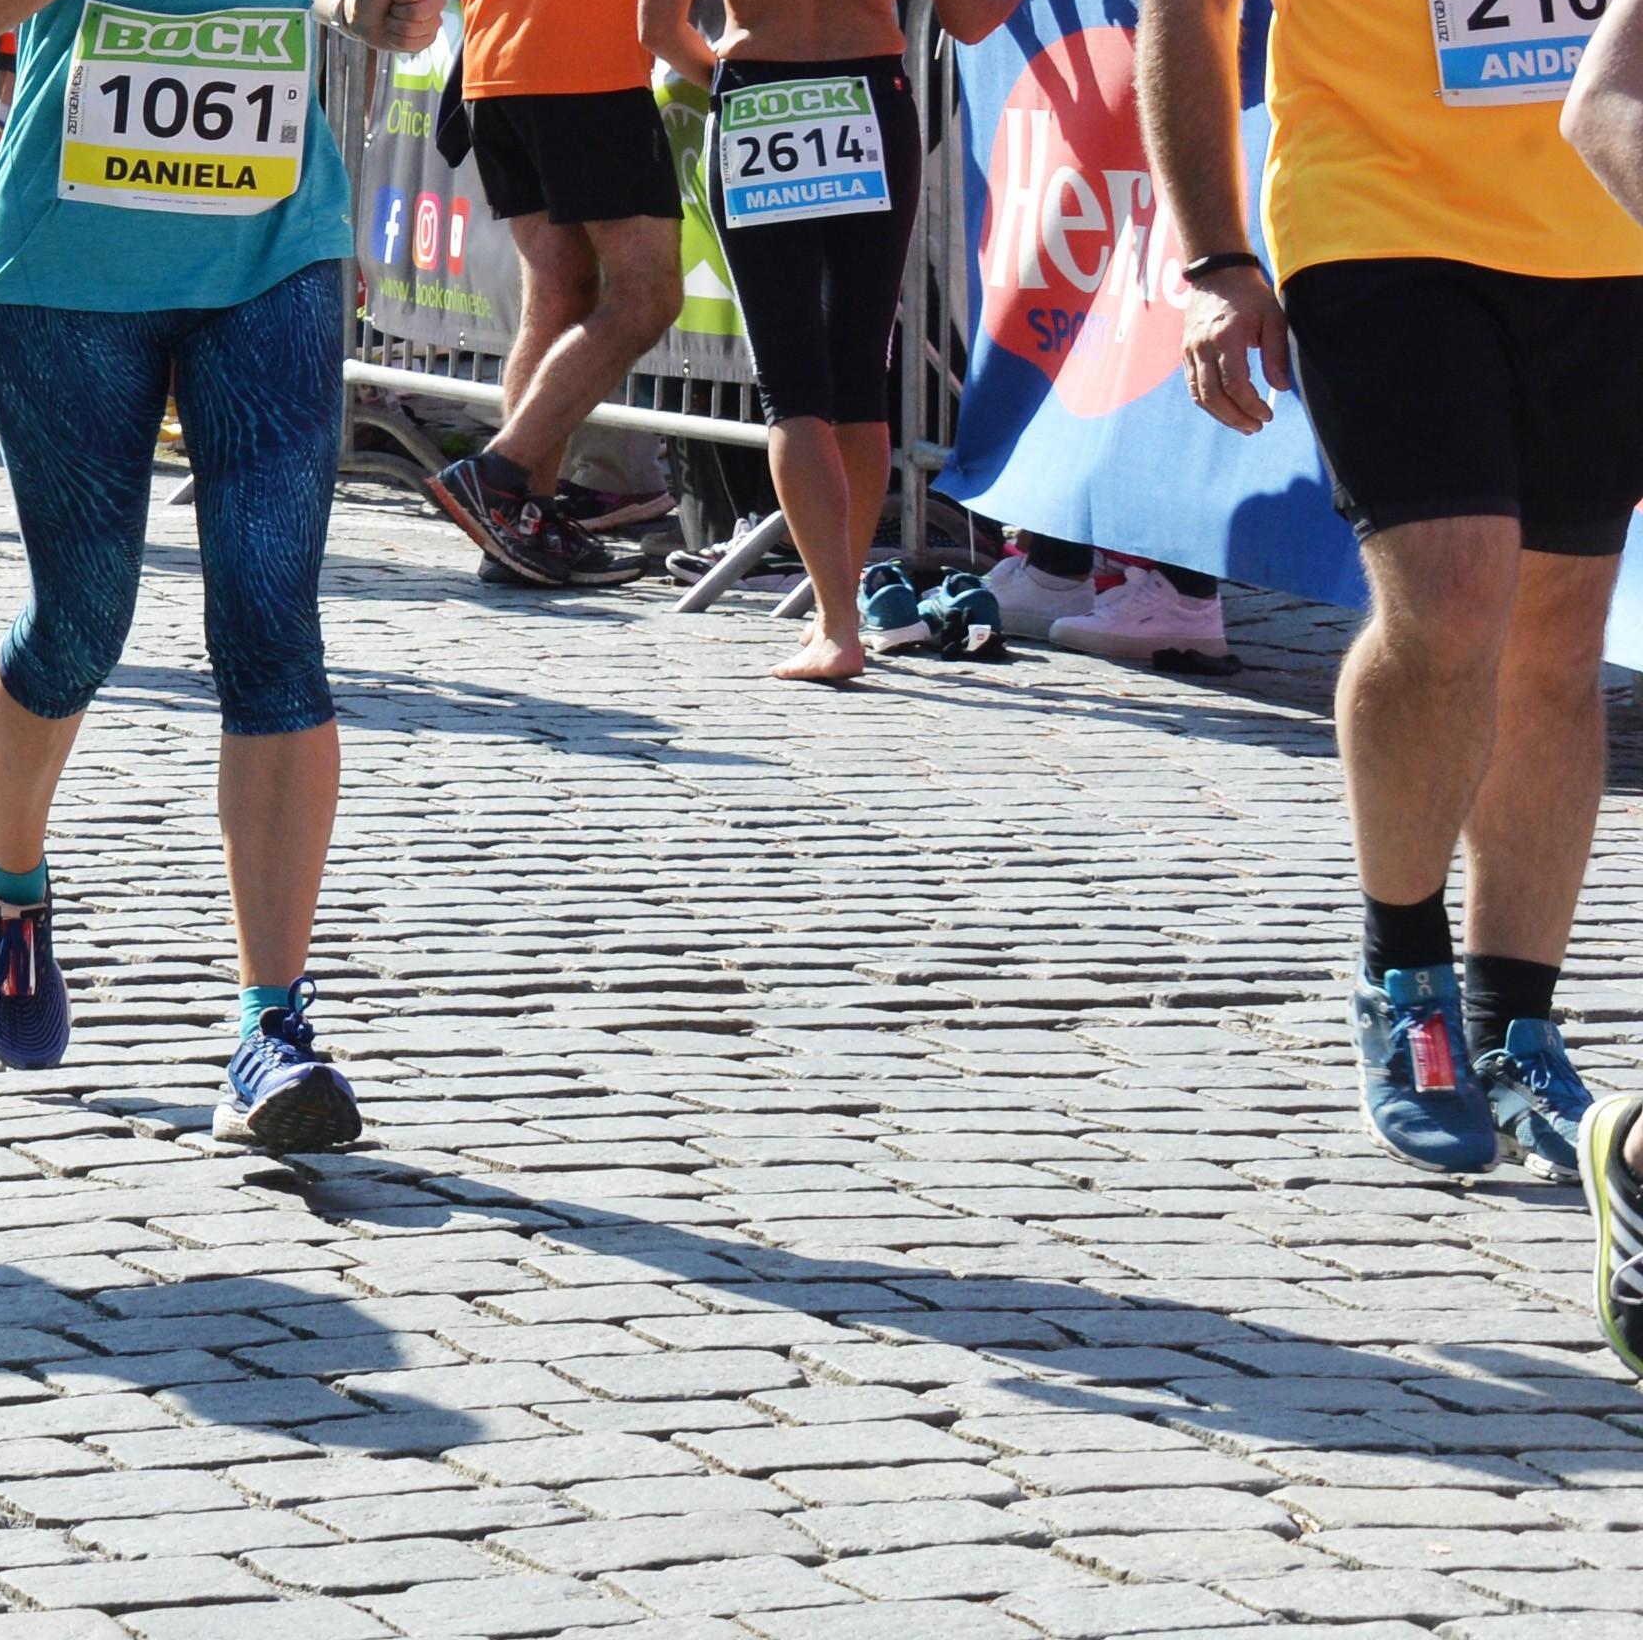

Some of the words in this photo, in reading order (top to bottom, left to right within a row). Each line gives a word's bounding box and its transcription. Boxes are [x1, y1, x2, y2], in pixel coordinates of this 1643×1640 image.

[99, 18, 286, 60] BOCK
[99, 74, 274, 143] 1061
[288, 89, 298, 100] D
[732, 86, 855, 122] BOCK
[386, 98, 431, 137] Office
[737, 124, 865, 178] 2614
[105, 156, 258, 190] DANIELA
[745, 178, 867, 209] MANUELA
